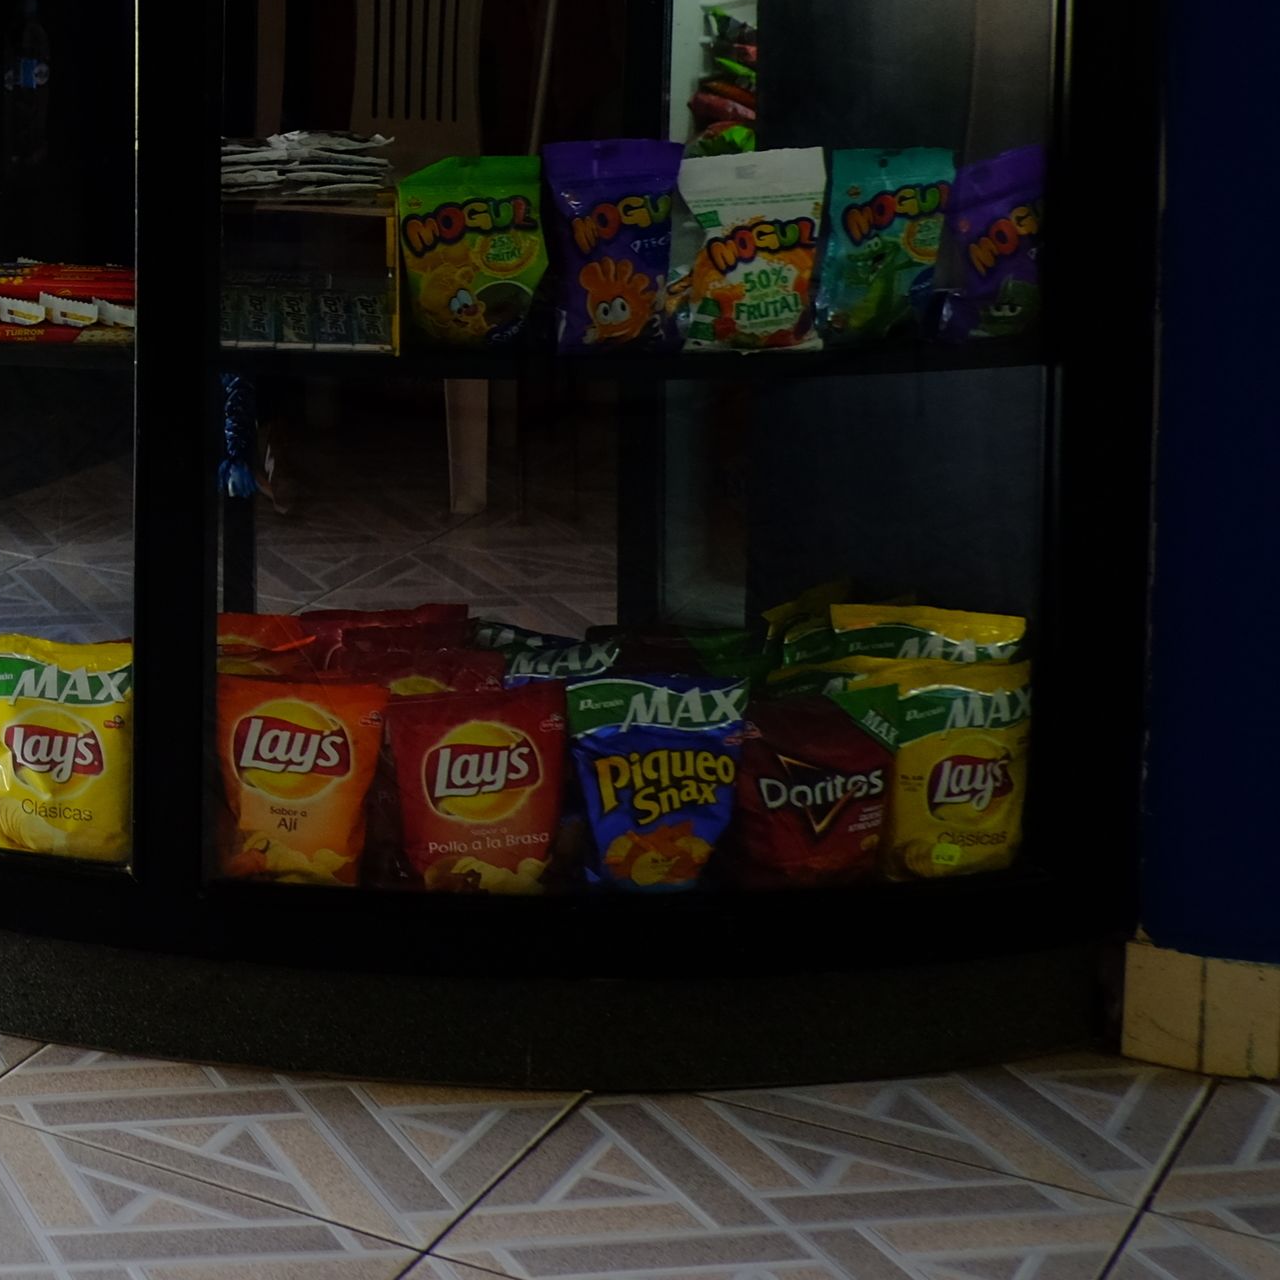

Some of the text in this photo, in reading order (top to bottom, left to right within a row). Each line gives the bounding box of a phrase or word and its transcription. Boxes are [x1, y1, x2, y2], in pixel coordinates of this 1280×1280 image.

[404, 196, 537, 257] MOGUL
[571, 194, 672, 255] MOGU
[707, 217, 817, 275] MOGUL
[744, 266, 789, 293] 50%
[735, 293, 800, 321] FRUTA!
[8, 664, 128, 706] MAX
[618, 685, 745, 734] MAX
[861, 708, 900, 745] MAX
[945, 686, 1032, 733] MAX
[12, 727, 96, 783] Lay's
[239, 718, 345, 774] Lay's
[434, 742, 531, 798] Lay's
[594, 748, 736, 814] Piqueo
[632, 778, 719, 826] Snax
[759, 769, 885, 809] Doritos
[21, 798, 93, 822] Clásicas
[428, 830, 550, 855] Pollo a la Brasa
